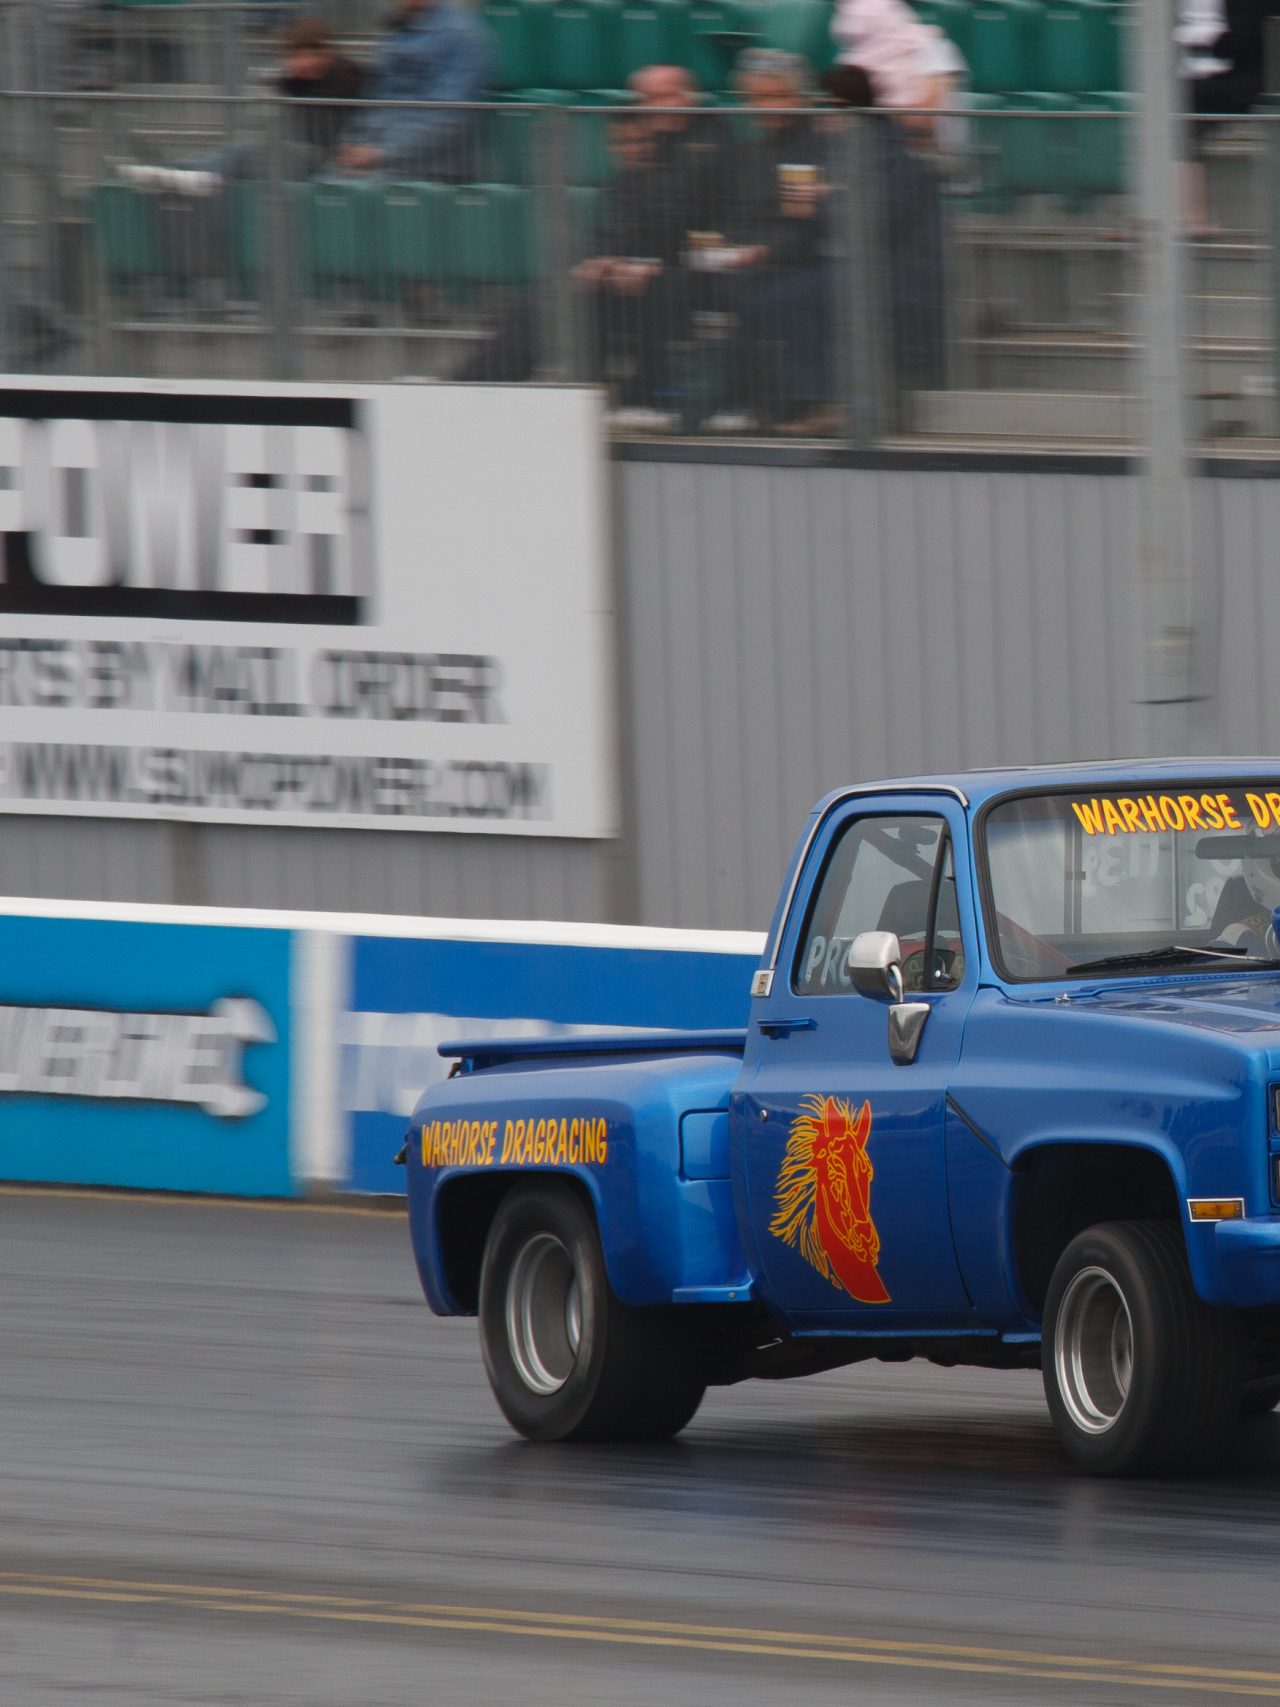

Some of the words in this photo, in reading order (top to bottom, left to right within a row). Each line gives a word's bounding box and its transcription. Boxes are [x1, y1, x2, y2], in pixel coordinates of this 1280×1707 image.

[172, 644, 306, 717] MAIL
[314, 648, 506, 724] ORDER
[1071, 794, 1242, 836] WARHORSE
[421, 1119, 499, 1168] WARHORSE
[500, 1117, 608, 1166] DRAGRACING
